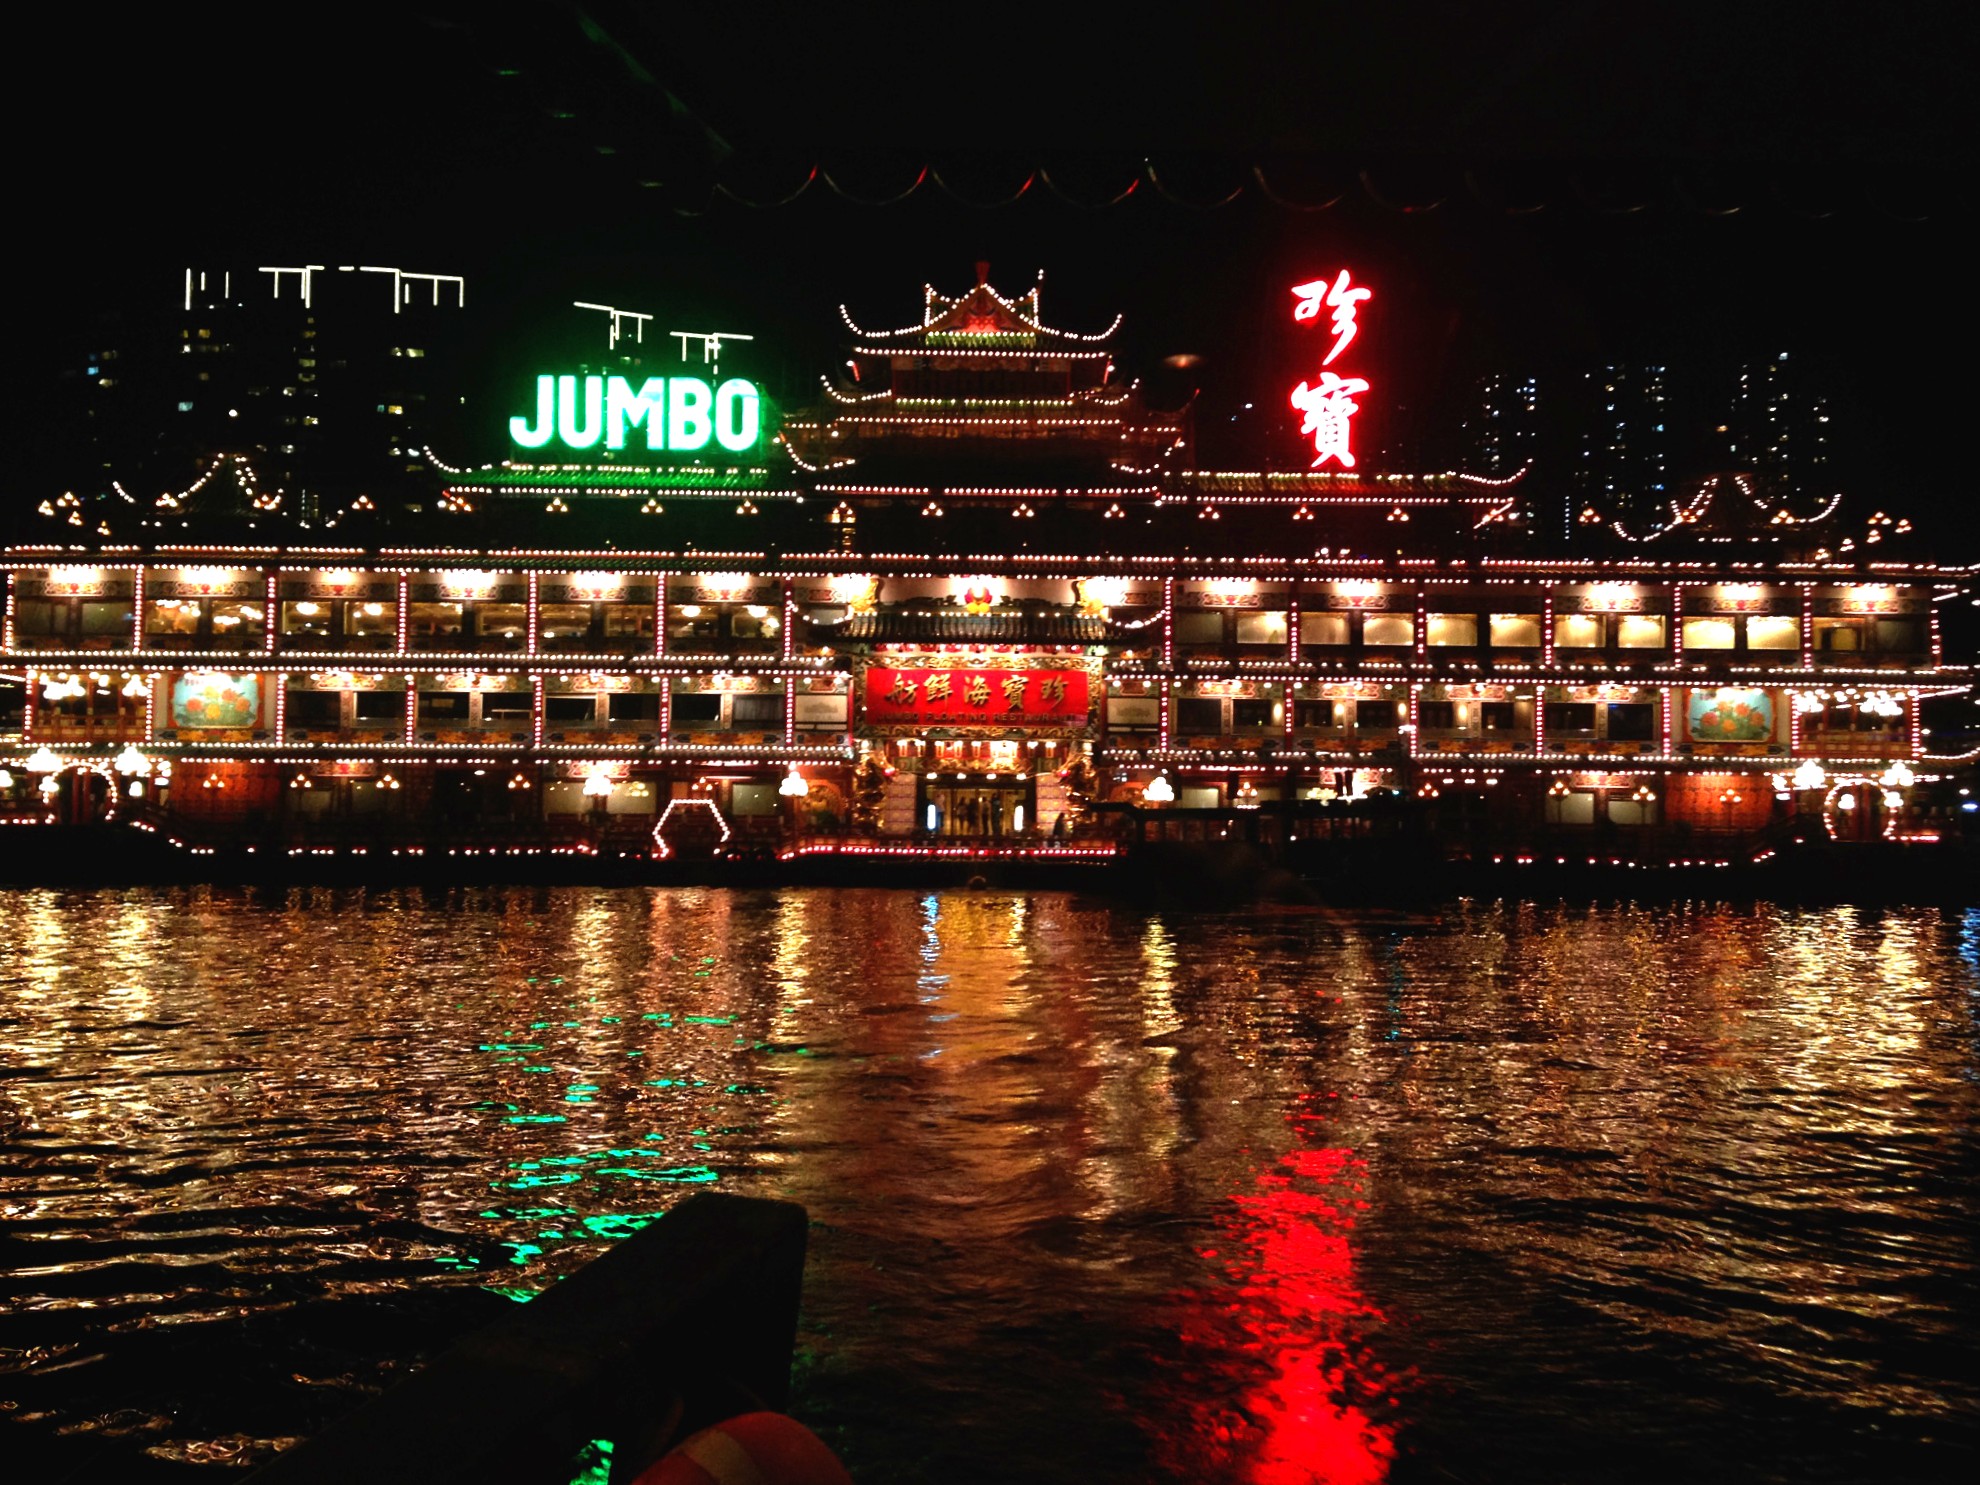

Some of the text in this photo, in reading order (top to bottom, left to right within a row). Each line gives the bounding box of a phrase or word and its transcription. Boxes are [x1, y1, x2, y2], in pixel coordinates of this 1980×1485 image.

[509, 375, 760, 450] JUMBO
[926, 711, 987, 722] FLOATING
[993, 711, 1076, 722] RESTAURANT
